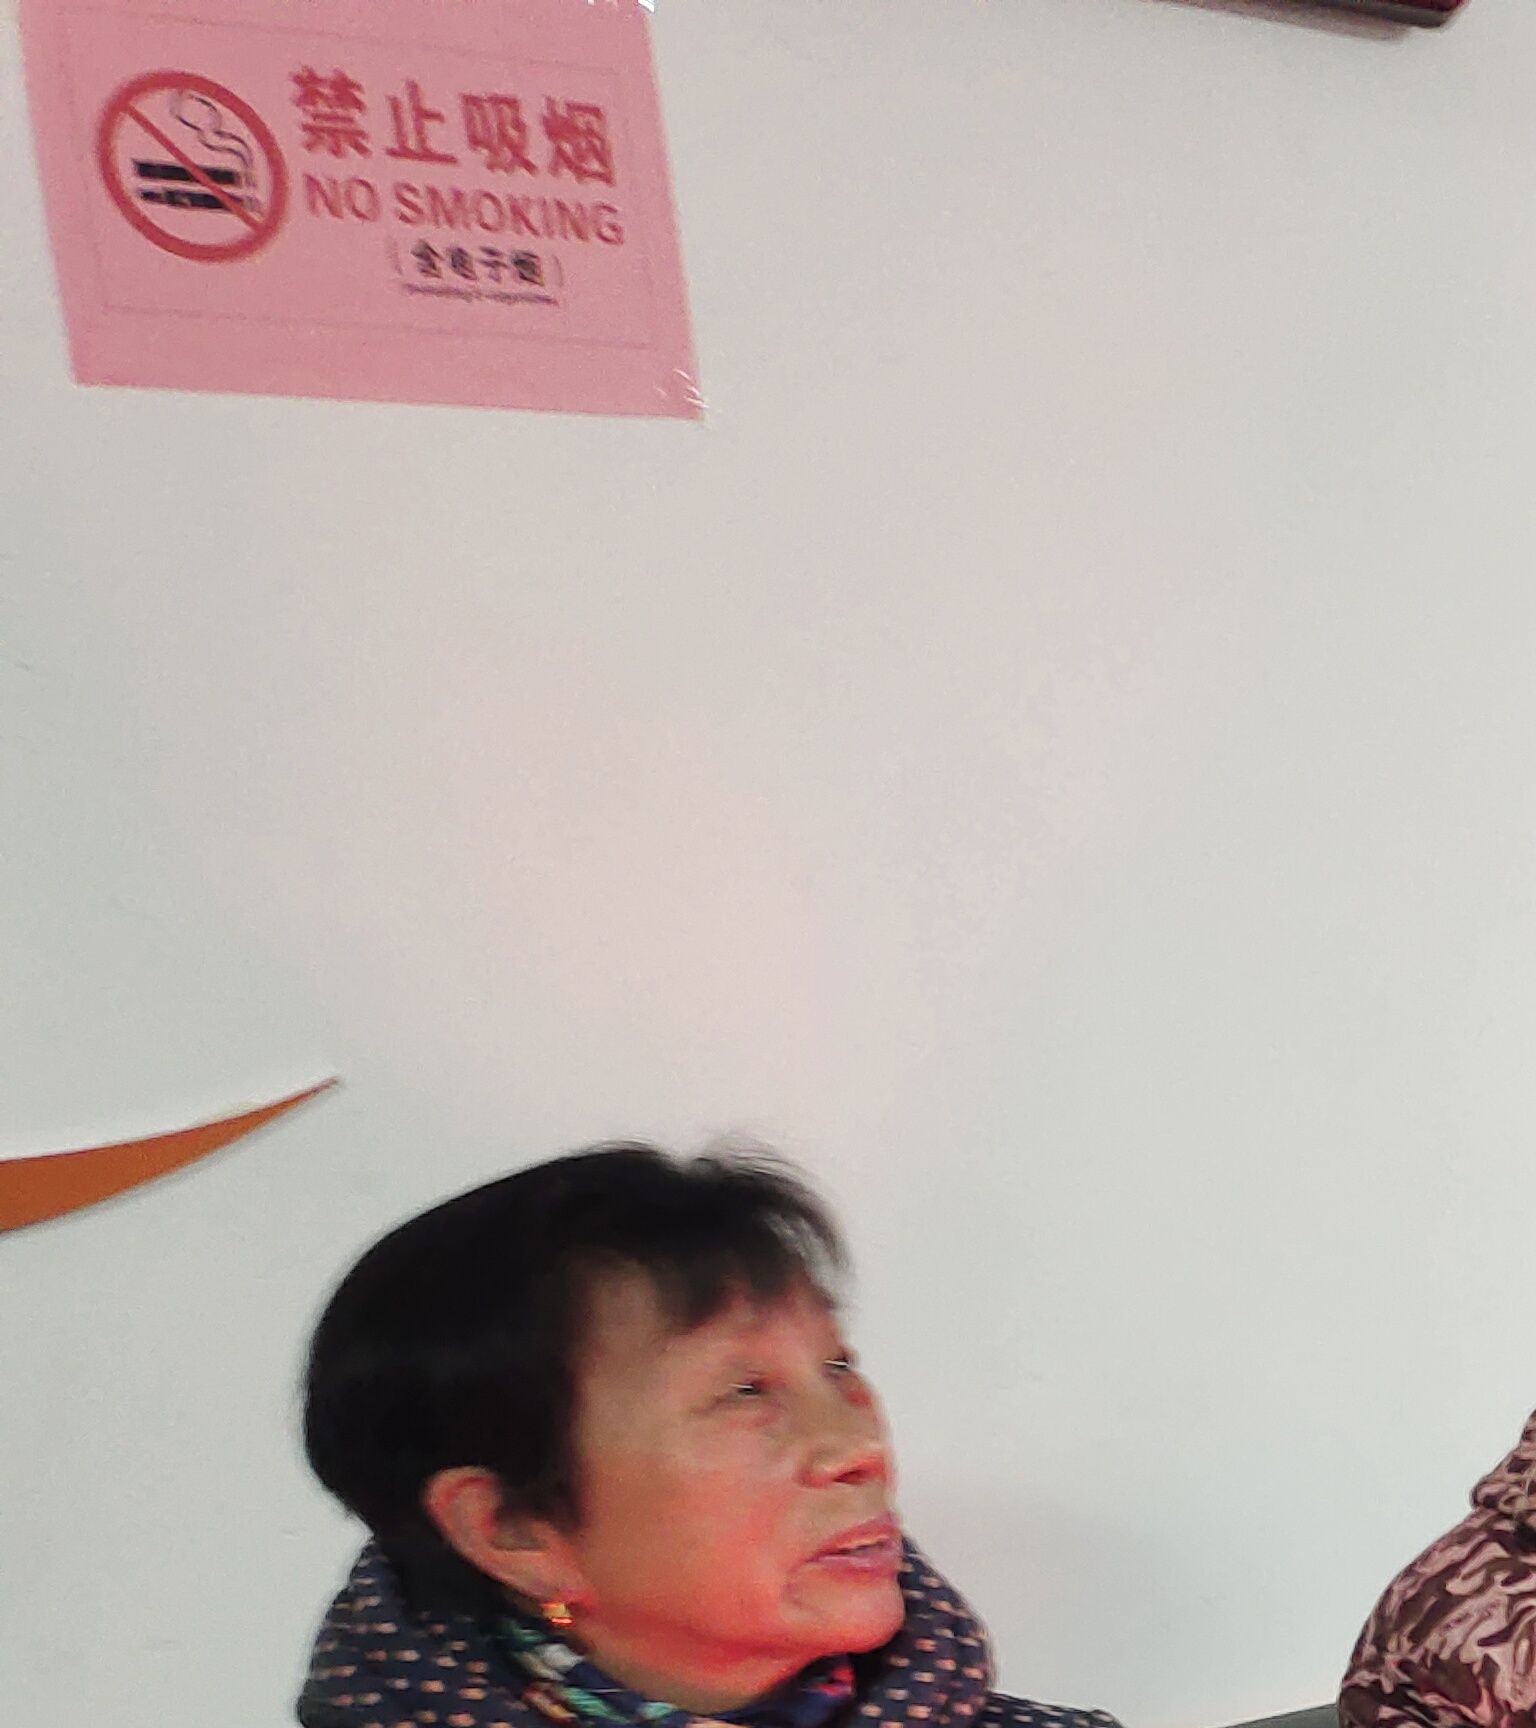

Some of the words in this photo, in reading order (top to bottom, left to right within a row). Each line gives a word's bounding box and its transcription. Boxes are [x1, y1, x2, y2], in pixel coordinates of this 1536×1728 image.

[289, 65, 617, 187] 禁止吸烟
[304, 173, 381, 224] NO
[396, 181, 625, 246] SMOKING
